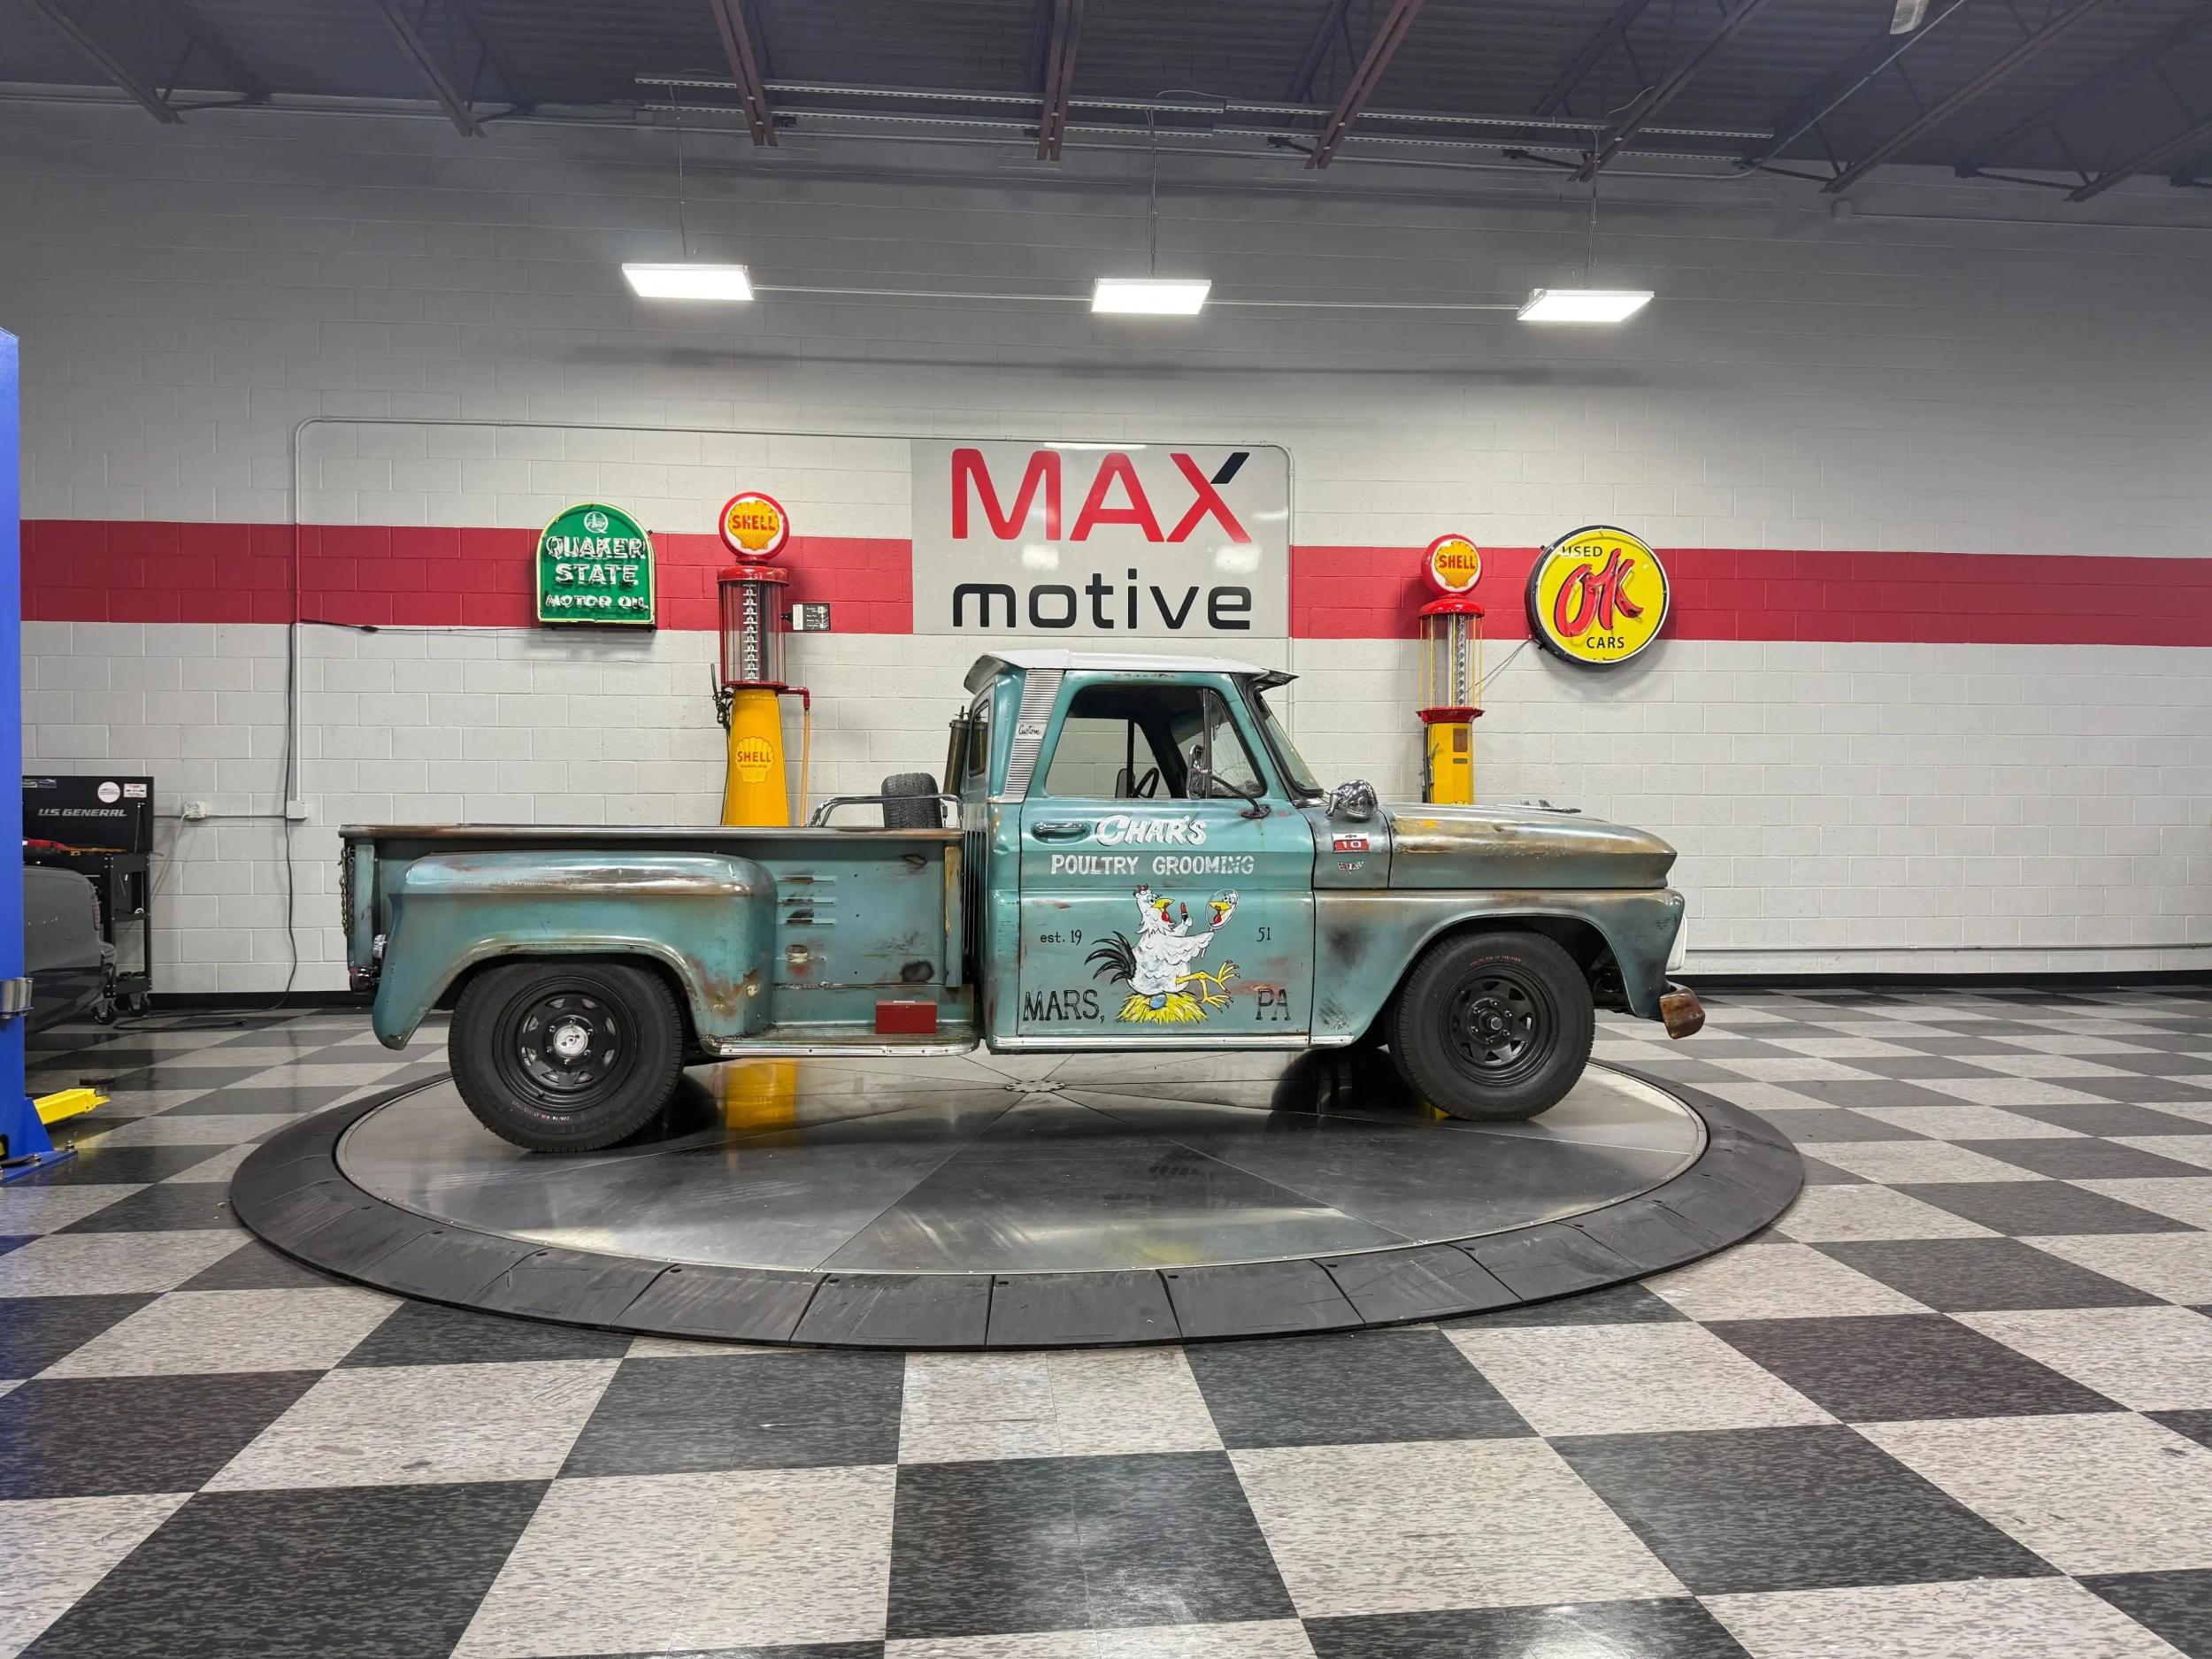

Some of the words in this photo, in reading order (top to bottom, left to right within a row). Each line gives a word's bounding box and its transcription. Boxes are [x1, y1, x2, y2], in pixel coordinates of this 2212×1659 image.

[951, 448, 1253, 543] MAX
[732, 514, 776, 531] SHELL
[546, 535, 646, 559] QUAKER
[1562, 546, 1602, 557] USED
[1438, 555, 1476, 569] SHELL
[555, 563, 639, 585] STATE
[545, 595, 612, 608] MOTOR
[618, 595, 649, 609] OIL
[953, 568, 1252, 630] motive
[1586, 636, 1624, 649] CARS
[1018, 724, 1041, 735] Custom
[737, 751, 772, 762] SHELL
[1051, 855, 1139, 875] POULTRY
[1152, 855, 1255, 875] GROOMING
[1040, 932, 1065, 943] est.
[1071, 929, 1082, 946] 19
[1256, 927, 1271, 942] 51
[1023, 988, 1105, 1024] MARS,
[1256, 987, 1291, 1021] PA
